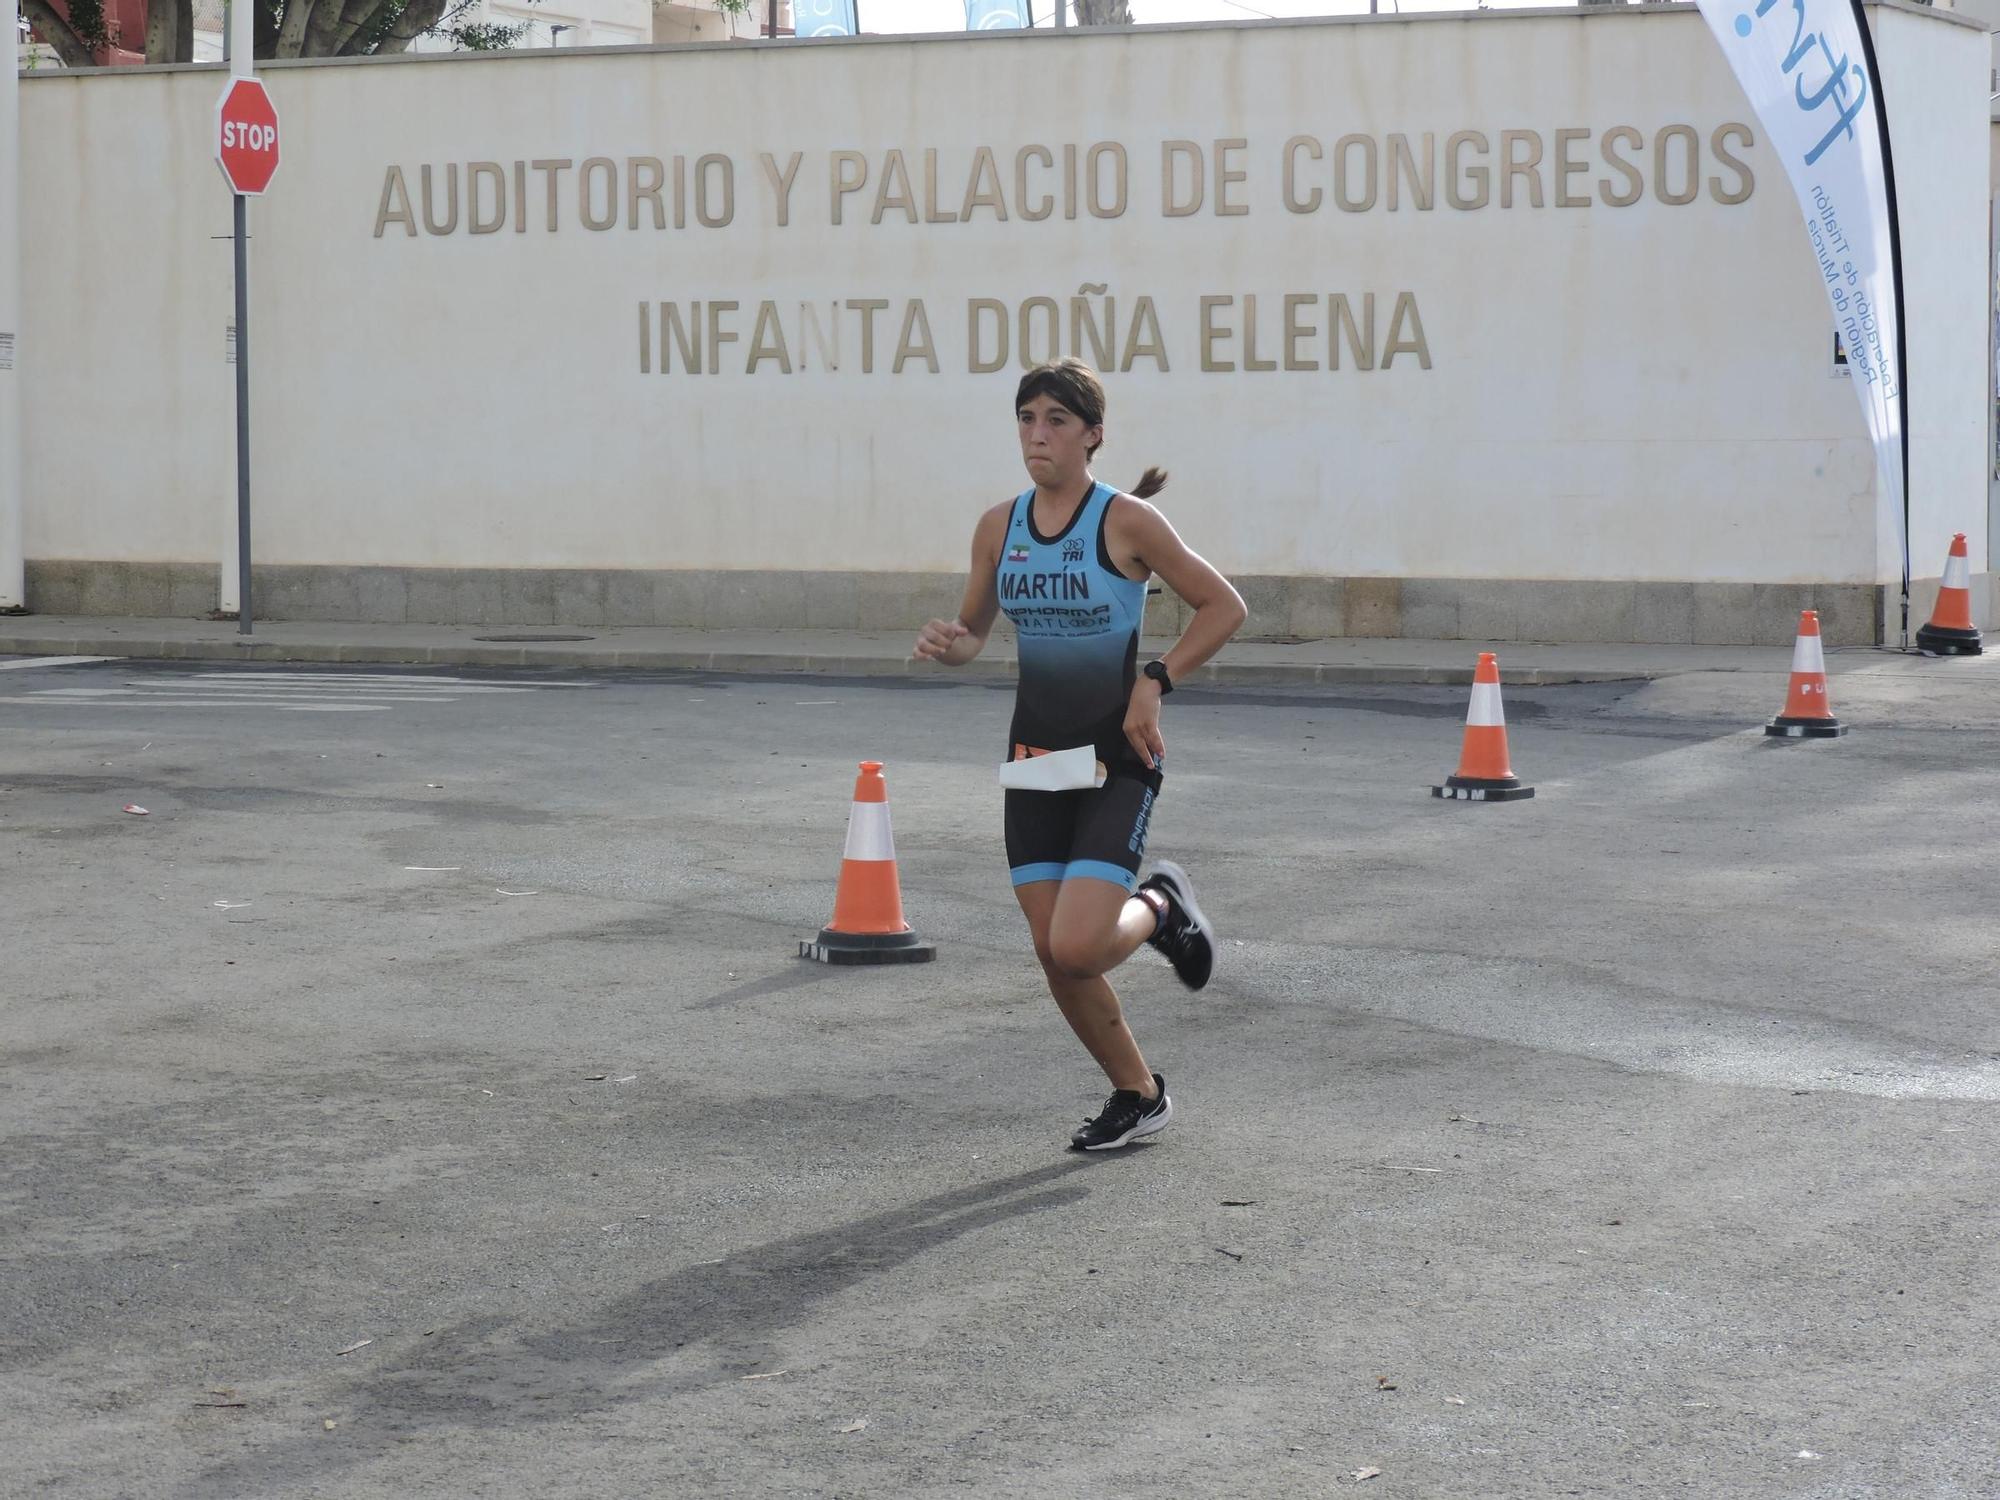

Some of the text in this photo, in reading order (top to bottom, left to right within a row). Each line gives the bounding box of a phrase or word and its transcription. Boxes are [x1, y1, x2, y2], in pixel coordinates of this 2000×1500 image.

[223, 121, 275, 151] STOP
[373, 122, 1755, 238] AUDITORIO Y PALACIO DE CONGRESOS
[639, 283, 1432, 374] INFANTA DOÑA ELENA
[1062, 551, 1083, 562] TRI
[1000, 565, 1089, 600] MARTÍN
